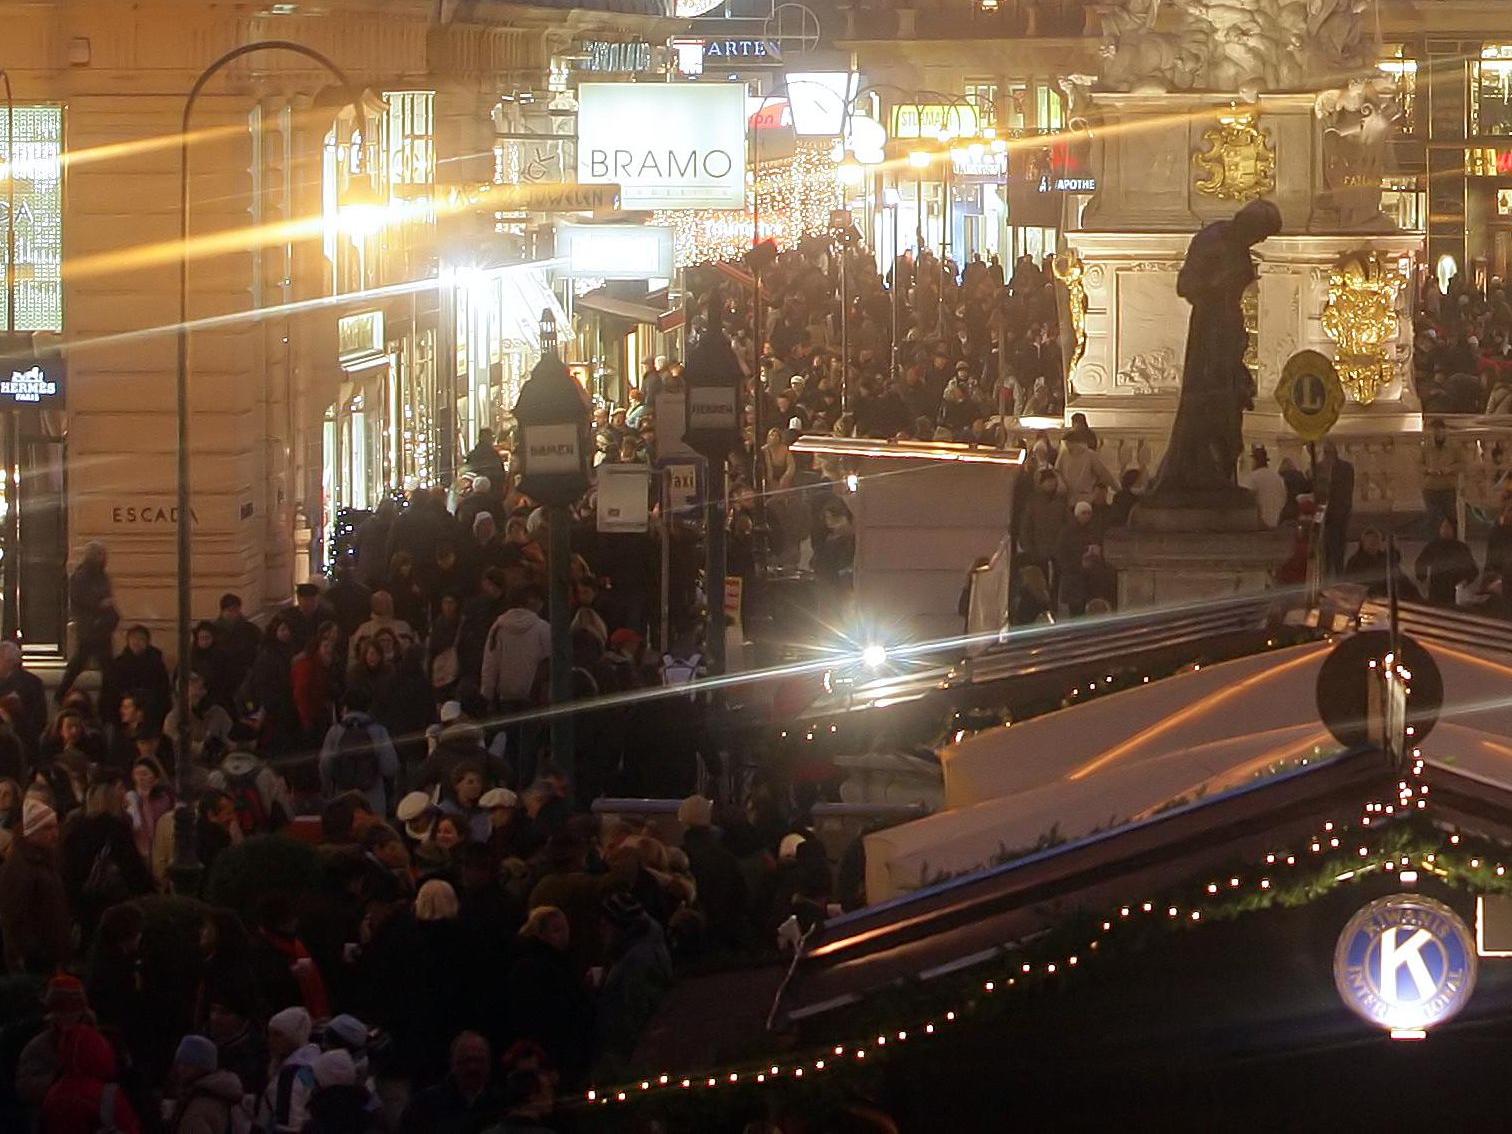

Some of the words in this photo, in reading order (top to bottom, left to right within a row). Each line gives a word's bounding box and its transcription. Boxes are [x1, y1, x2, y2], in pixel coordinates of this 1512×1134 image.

[703, 41, 781, 56] ARTEN
[591, 149, 732, 179] BRAMO
[1379, 927, 1438, 1005] K
